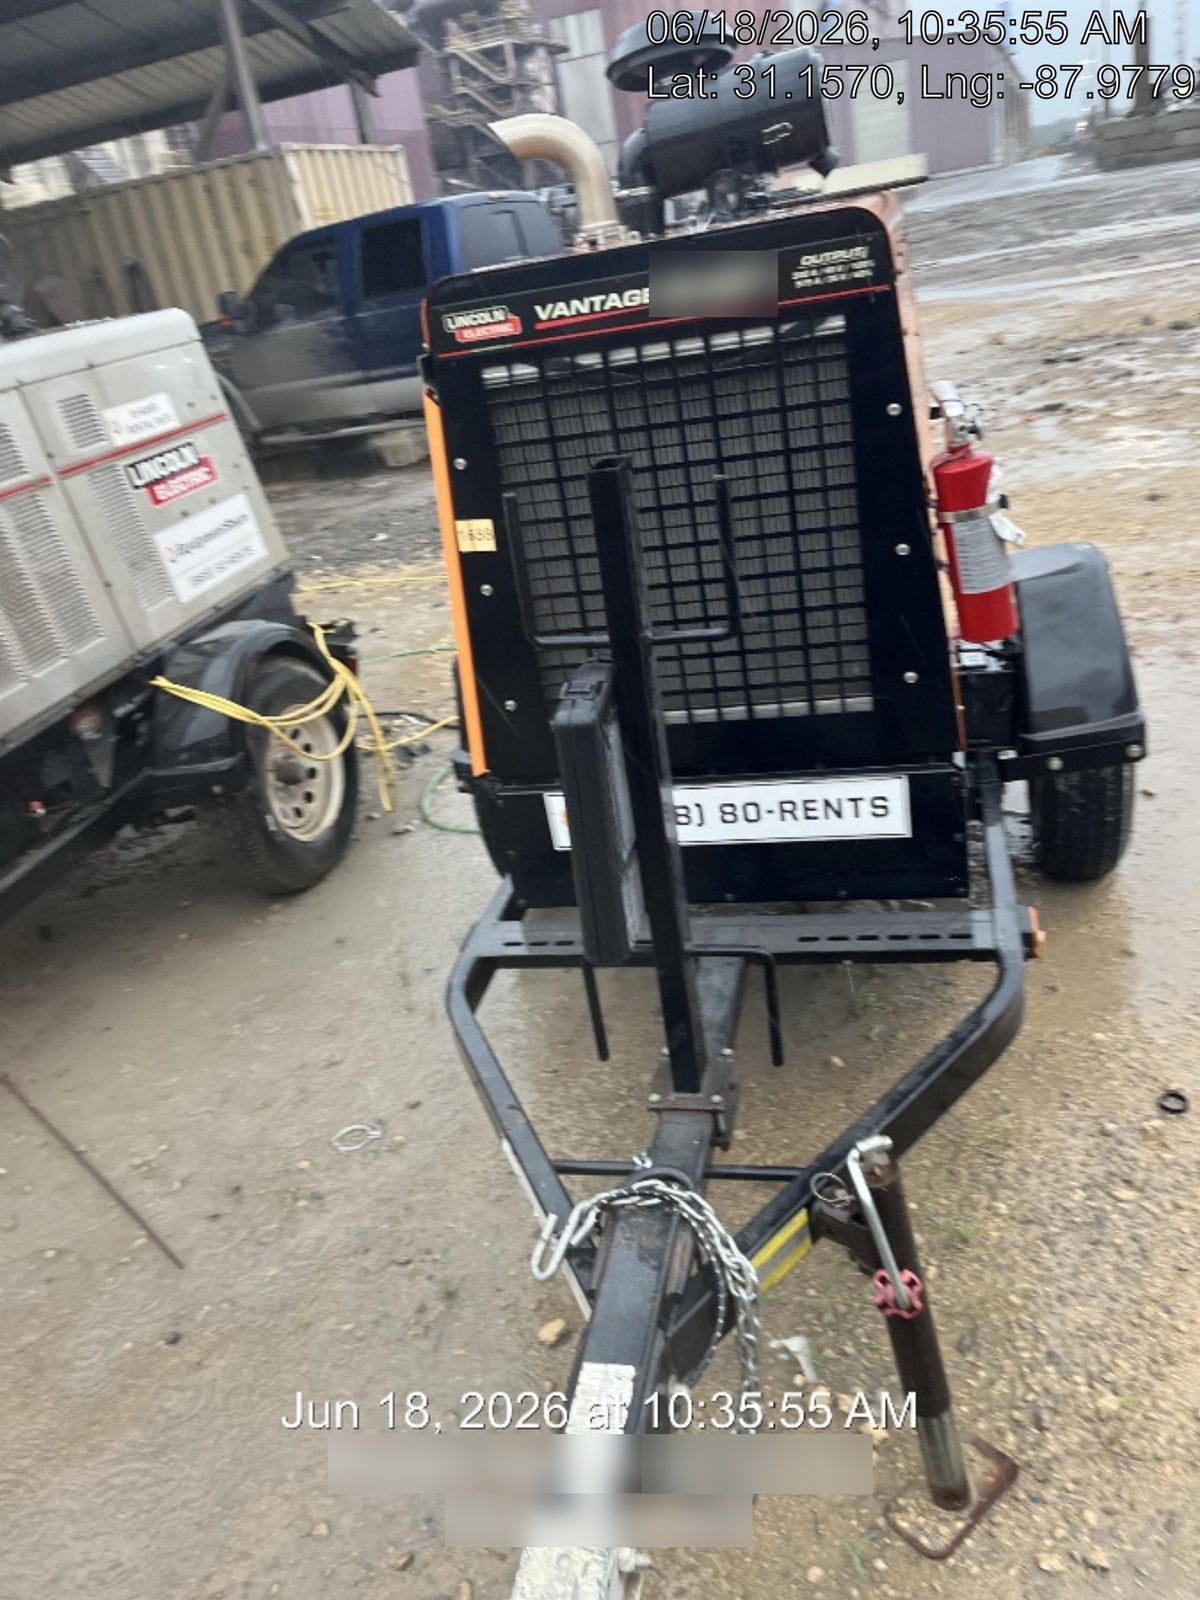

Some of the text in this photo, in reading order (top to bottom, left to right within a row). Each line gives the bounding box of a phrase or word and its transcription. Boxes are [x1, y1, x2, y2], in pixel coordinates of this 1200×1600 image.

[446, 309, 507, 329] LINCOLN
[463, 322, 516, 339] ELECTRIC
[127, 446, 200, 487] LINCOLN
[719, 795, 890, 825] 80-RENTS
